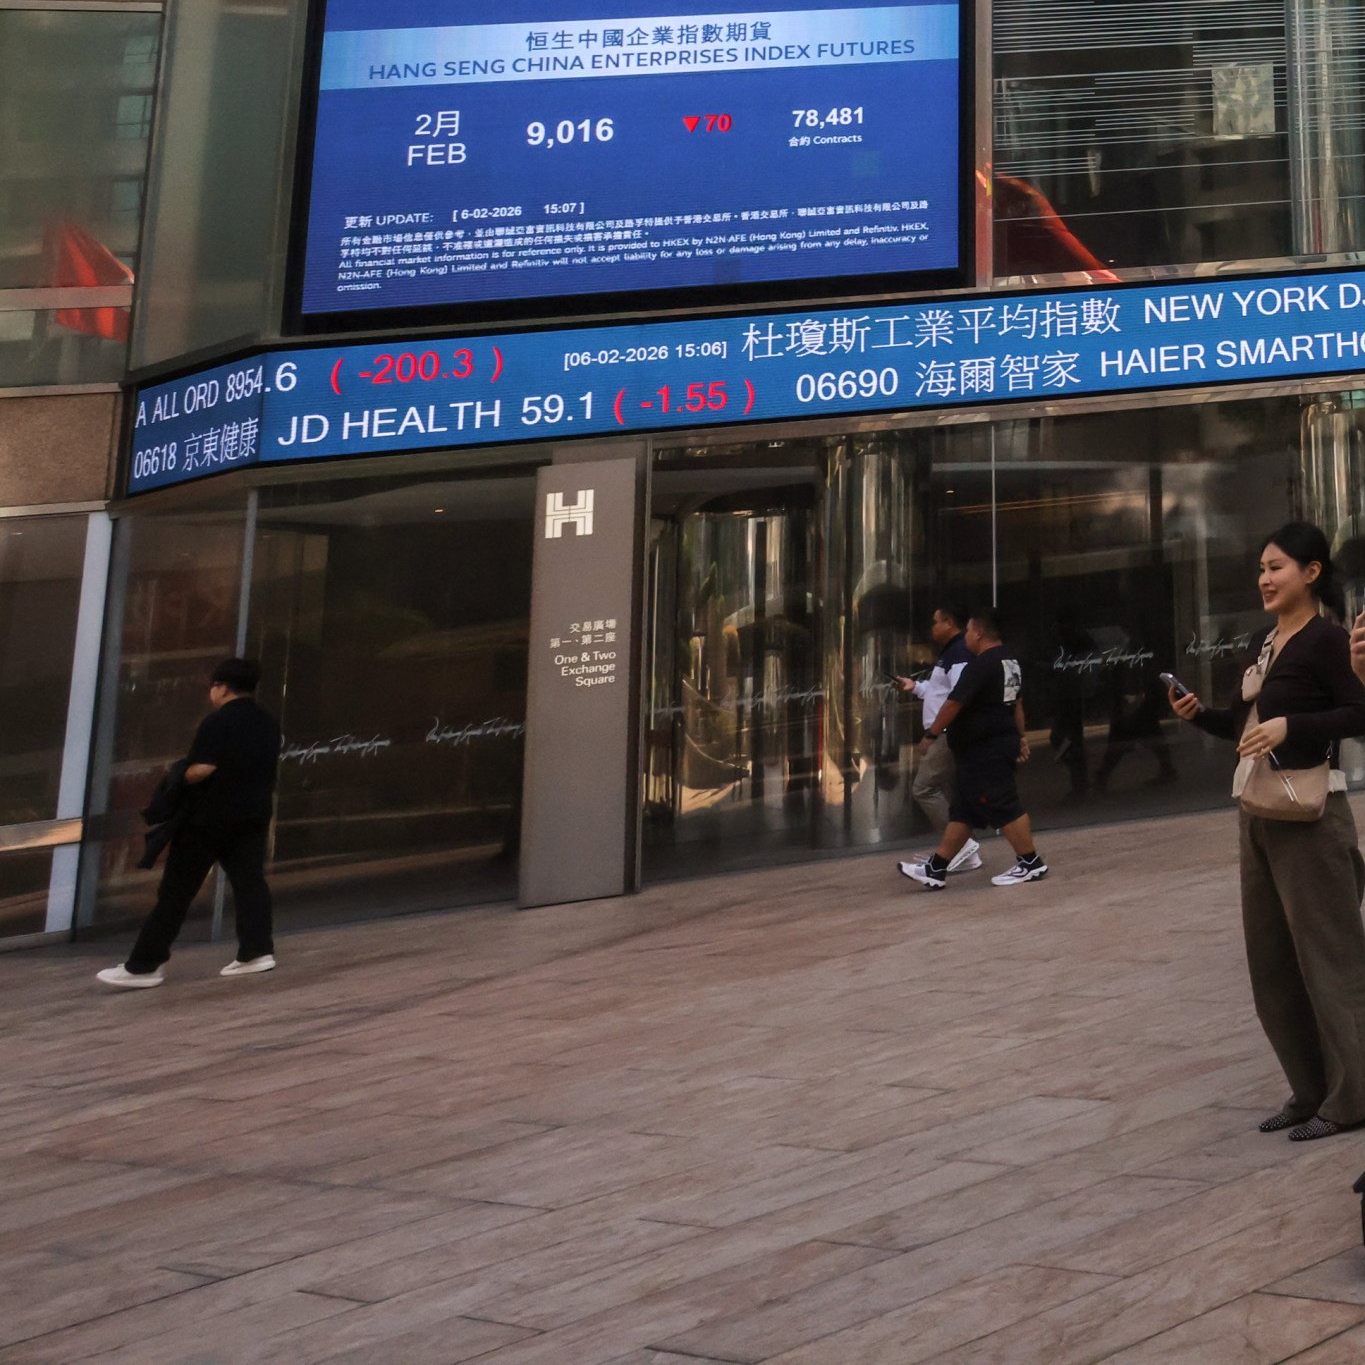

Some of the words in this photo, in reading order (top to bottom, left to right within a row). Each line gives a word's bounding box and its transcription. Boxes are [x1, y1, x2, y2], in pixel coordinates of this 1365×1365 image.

[525, 21, 772, 53] 恒生中國企業指數期貨
[368, 62, 436, 80] HANG
[443, 59, 505, 76] SENG
[512, 55, 584, 73] CHINA
[591, 48, 738, 69] ENTERPRISES
[745, 44, 811, 61] INDEX
[818, 39, 916, 58] FUTURES
[415, 110, 460, 138] 2月
[703, 114, 732, 133] 70
[792, 107, 863, 129] 78,481
[527, 118, 614, 149] 9,016
[788, 136, 811, 147] 合約
[813, 135, 862, 144] Contracts
[407, 143, 466, 166] FEB
[376, 212, 434, 226] UPDATE:
[461, 206, 522, 219] 6-02-2026
[544, 202, 577, 214] 15:07
[338, 260, 353, 269] All
[355, 258, 395, 267] financial
[397, 256, 432, 264] market
[434, 253, 489, 262] information
[502, 249, 516, 258] for
[518, 248, 562, 256] reference
[135, 401, 146, 428] A
[151, 392, 180, 423] ALL
[184, 380, 219, 412] ORD
[225, 362, 297, 402] 8954.6
[359, 348, 473, 384] -200.3
[741, 296, 1123, 363] 杜瓊斯工業平均指數
[1145, 293, 1224, 324] NEW
[1232, 285, 1330, 316] YORK
[134, 442, 177, 479] 06618
[182, 417, 259, 471] 京東健康
[278, 414, 329, 445] JD
[342, 400, 501, 440] HEALTH
[521, 391, 592, 425] 59.1
[640, 381, 728, 413] -1.55
[796, 367, 898, 402] 06690
[915, 350, 1081, 397] 海爾智家
[1101, 344, 1206, 377] HAIER
[570, 619, 616, 633] 交易廣場
[554, 654, 578, 665] One
[581, 653, 590, 661] &
[593, 651, 616, 661] Two
[561, 663, 616, 676] Exchange
[575, 675, 615, 688] Square
